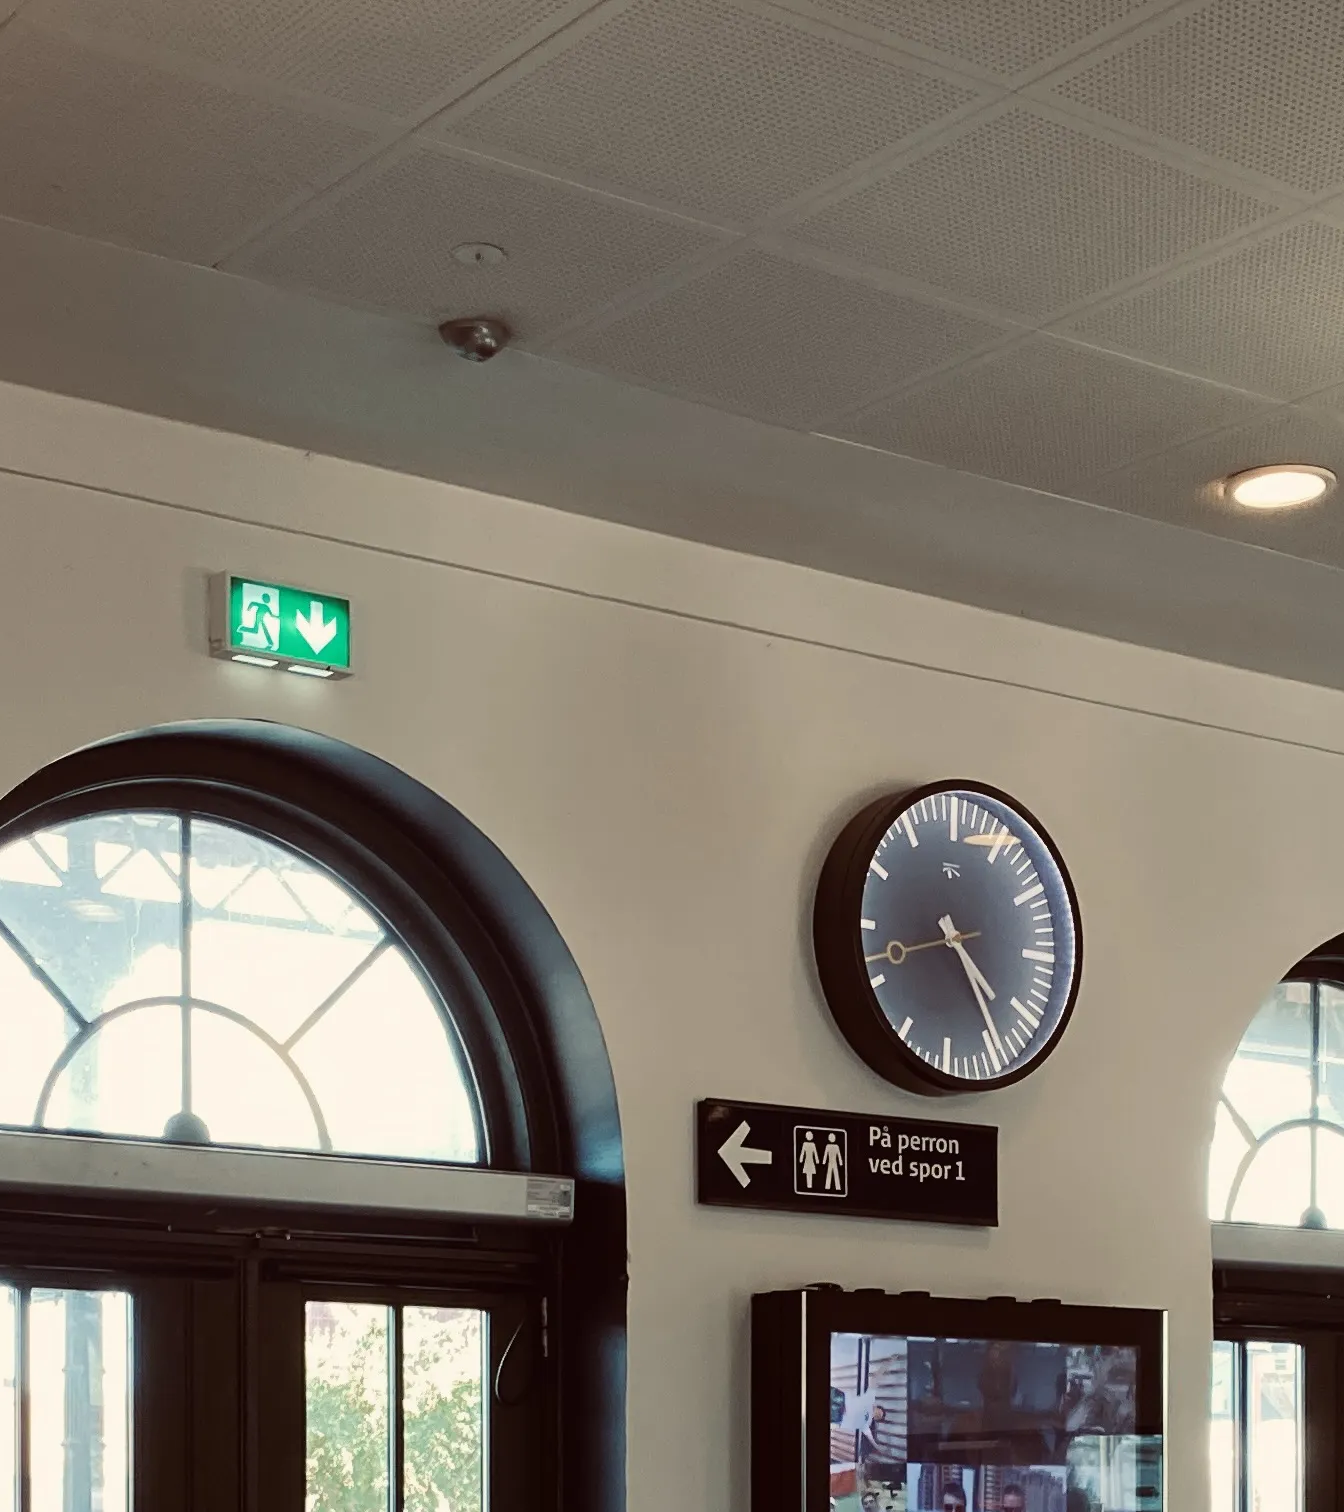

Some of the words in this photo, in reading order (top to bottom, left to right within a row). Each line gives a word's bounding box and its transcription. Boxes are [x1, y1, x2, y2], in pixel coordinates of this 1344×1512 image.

[869, 1126, 891, 1148] På
[898, 1133, 959, 1155] perron
[868, 1156, 903, 1175] ved
[909, 1161, 952, 1182] spor
[955, 1161, 965, 1181] 1
